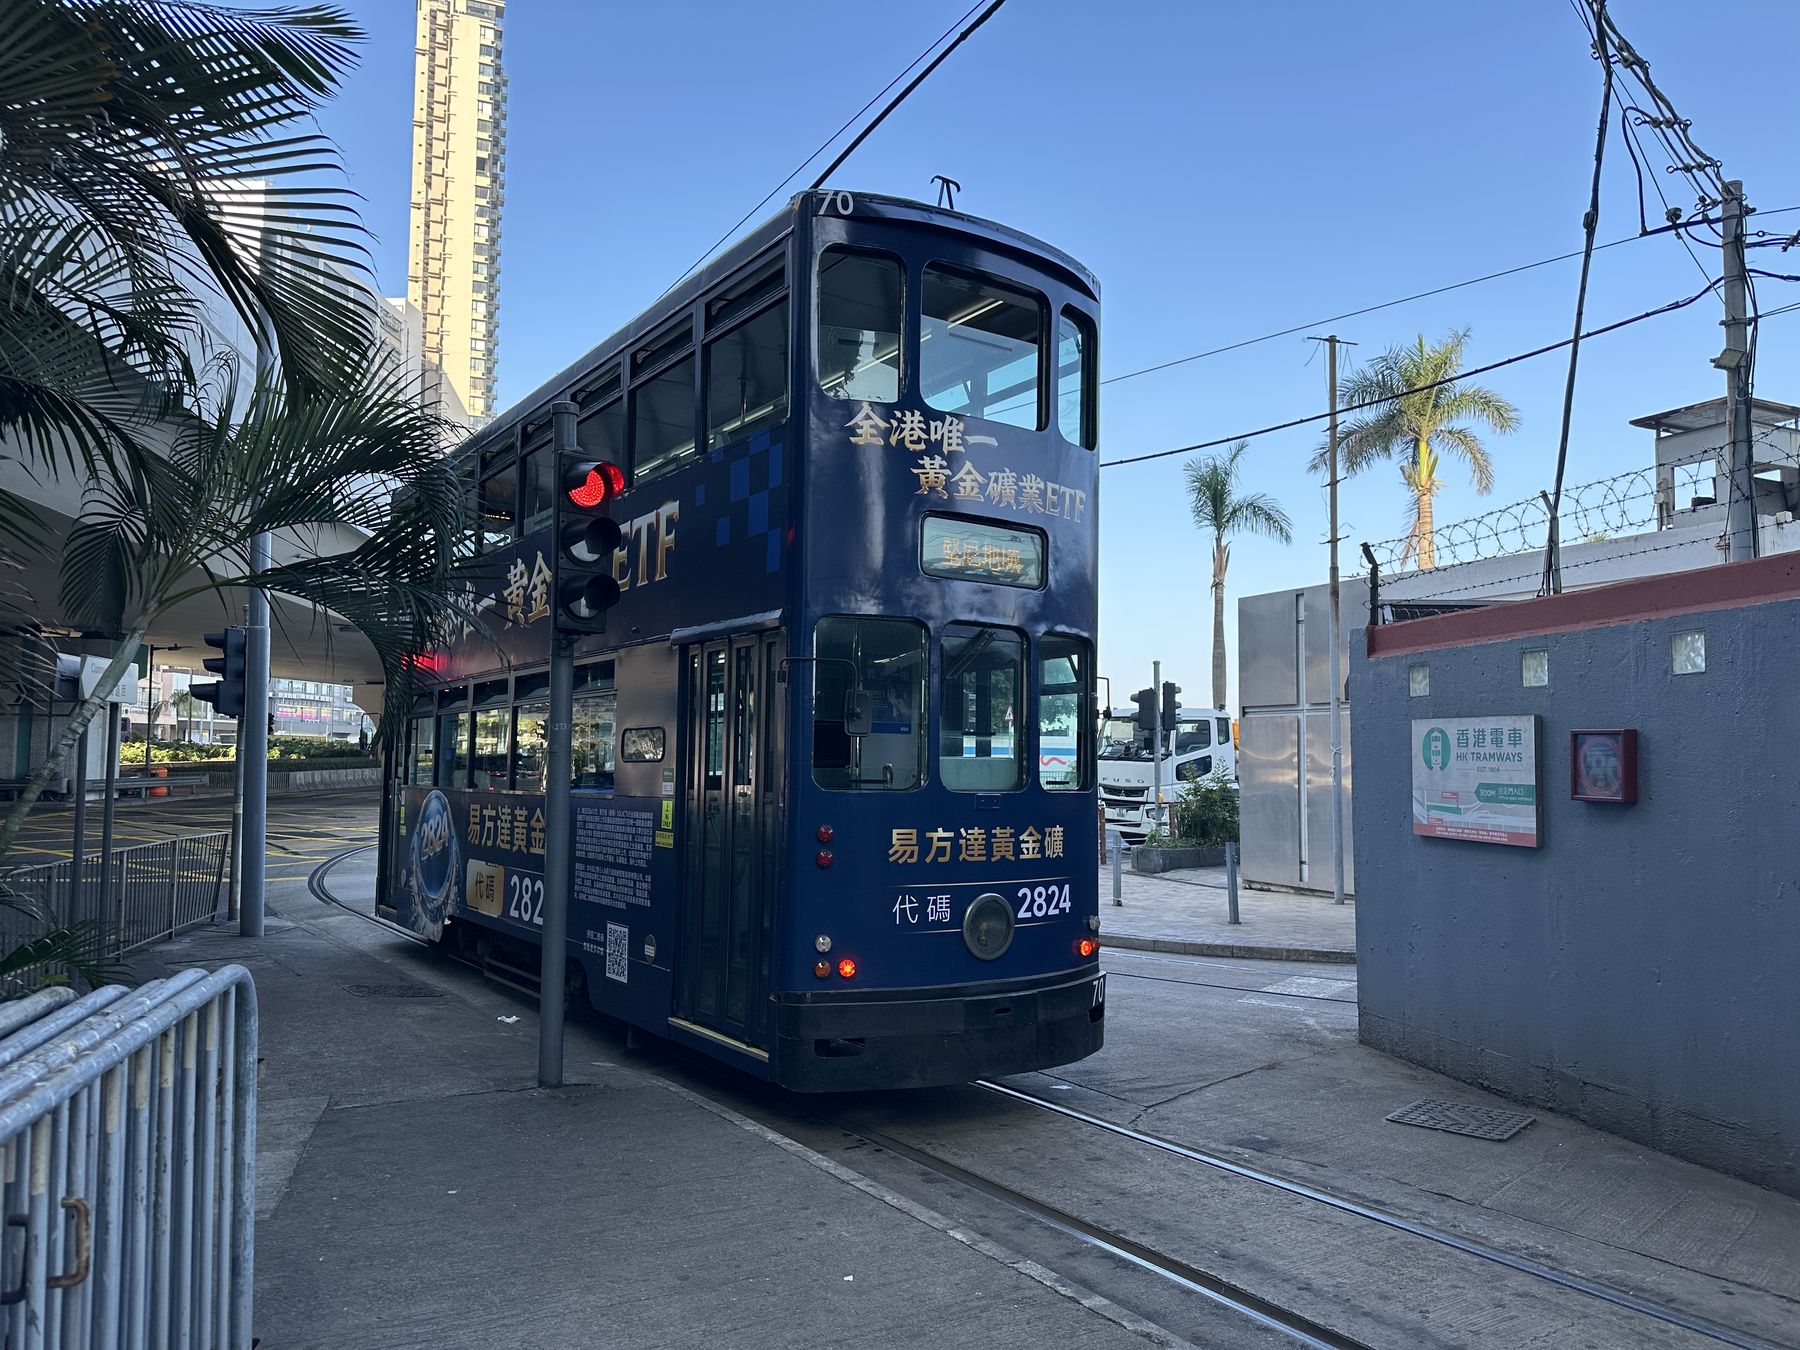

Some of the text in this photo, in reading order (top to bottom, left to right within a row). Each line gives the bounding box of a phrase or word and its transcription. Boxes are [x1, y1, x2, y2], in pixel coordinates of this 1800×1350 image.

[817, 191, 854, 216] 70
[844, 402, 998, 455] 全港唯一
[910, 455, 1087, 523] 黃金礦業ETF
[612, 500, 680, 592] ETF
[1456, 727, 1523, 748] 香港電車
[1456, 751, 1523, 763] HK TRAMWAYS
[420, 811, 449, 862] 2824
[888, 824, 1065, 865] 易方達黃金礦
[474, 870, 496, 903] 代碼
[1016, 883, 1072, 919] 2824
[892, 893, 951, 925] 代碼
[1092, 979, 1104, 1008] 70
